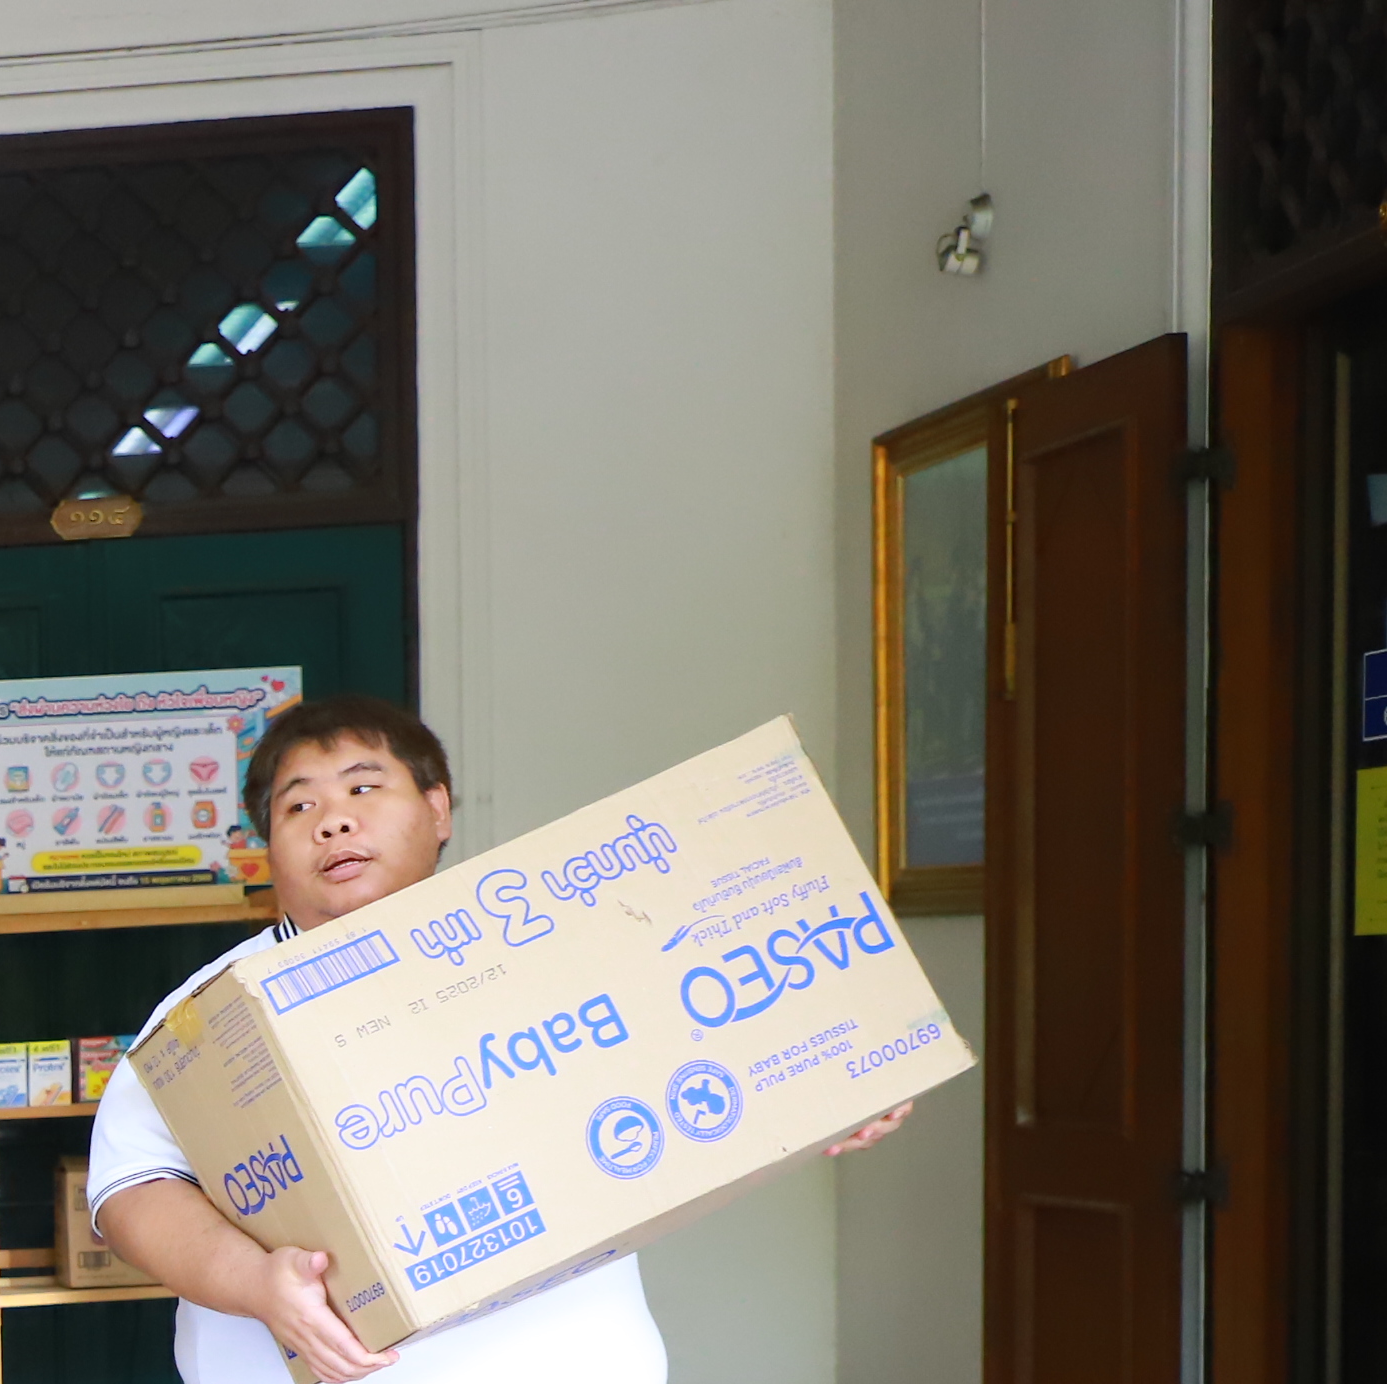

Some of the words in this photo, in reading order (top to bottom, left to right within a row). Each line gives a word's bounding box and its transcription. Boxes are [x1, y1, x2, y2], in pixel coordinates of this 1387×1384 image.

[541, 815, 676, 906] นุ่มกว่า
[792, 875, 829, 900] Fluffy
[476, 869, 553, 946] 3
[760, 893, 789, 914] Soft
[732, 906, 758, 929] and
[410, 909, 481, 965] เท่า
[691, 920, 731, 946] Thick
[681, 893, 893, 1026] PASEO
[436, 964, 505, 1002] 12/2025
[356, 1015, 390, 1037] NEW
[809, 1019, 857, 1046] TISSUES
[781, 1042, 808, 1059] FOR
[821, 1040, 852, 1059] 100%
[846, 1023, 940, 1077] 69700073
[749, 1054, 780, 1076] BABY
[786, 1054, 819, 1076] PURE
[755, 1071, 785, 1091] PULP
[224, 1135, 302, 1217] PASEO
[506, 1188, 522, 1207] 6
[415, 1216, 538, 1284] 101327019
[346, 1282, 384, 1311] 69700073
